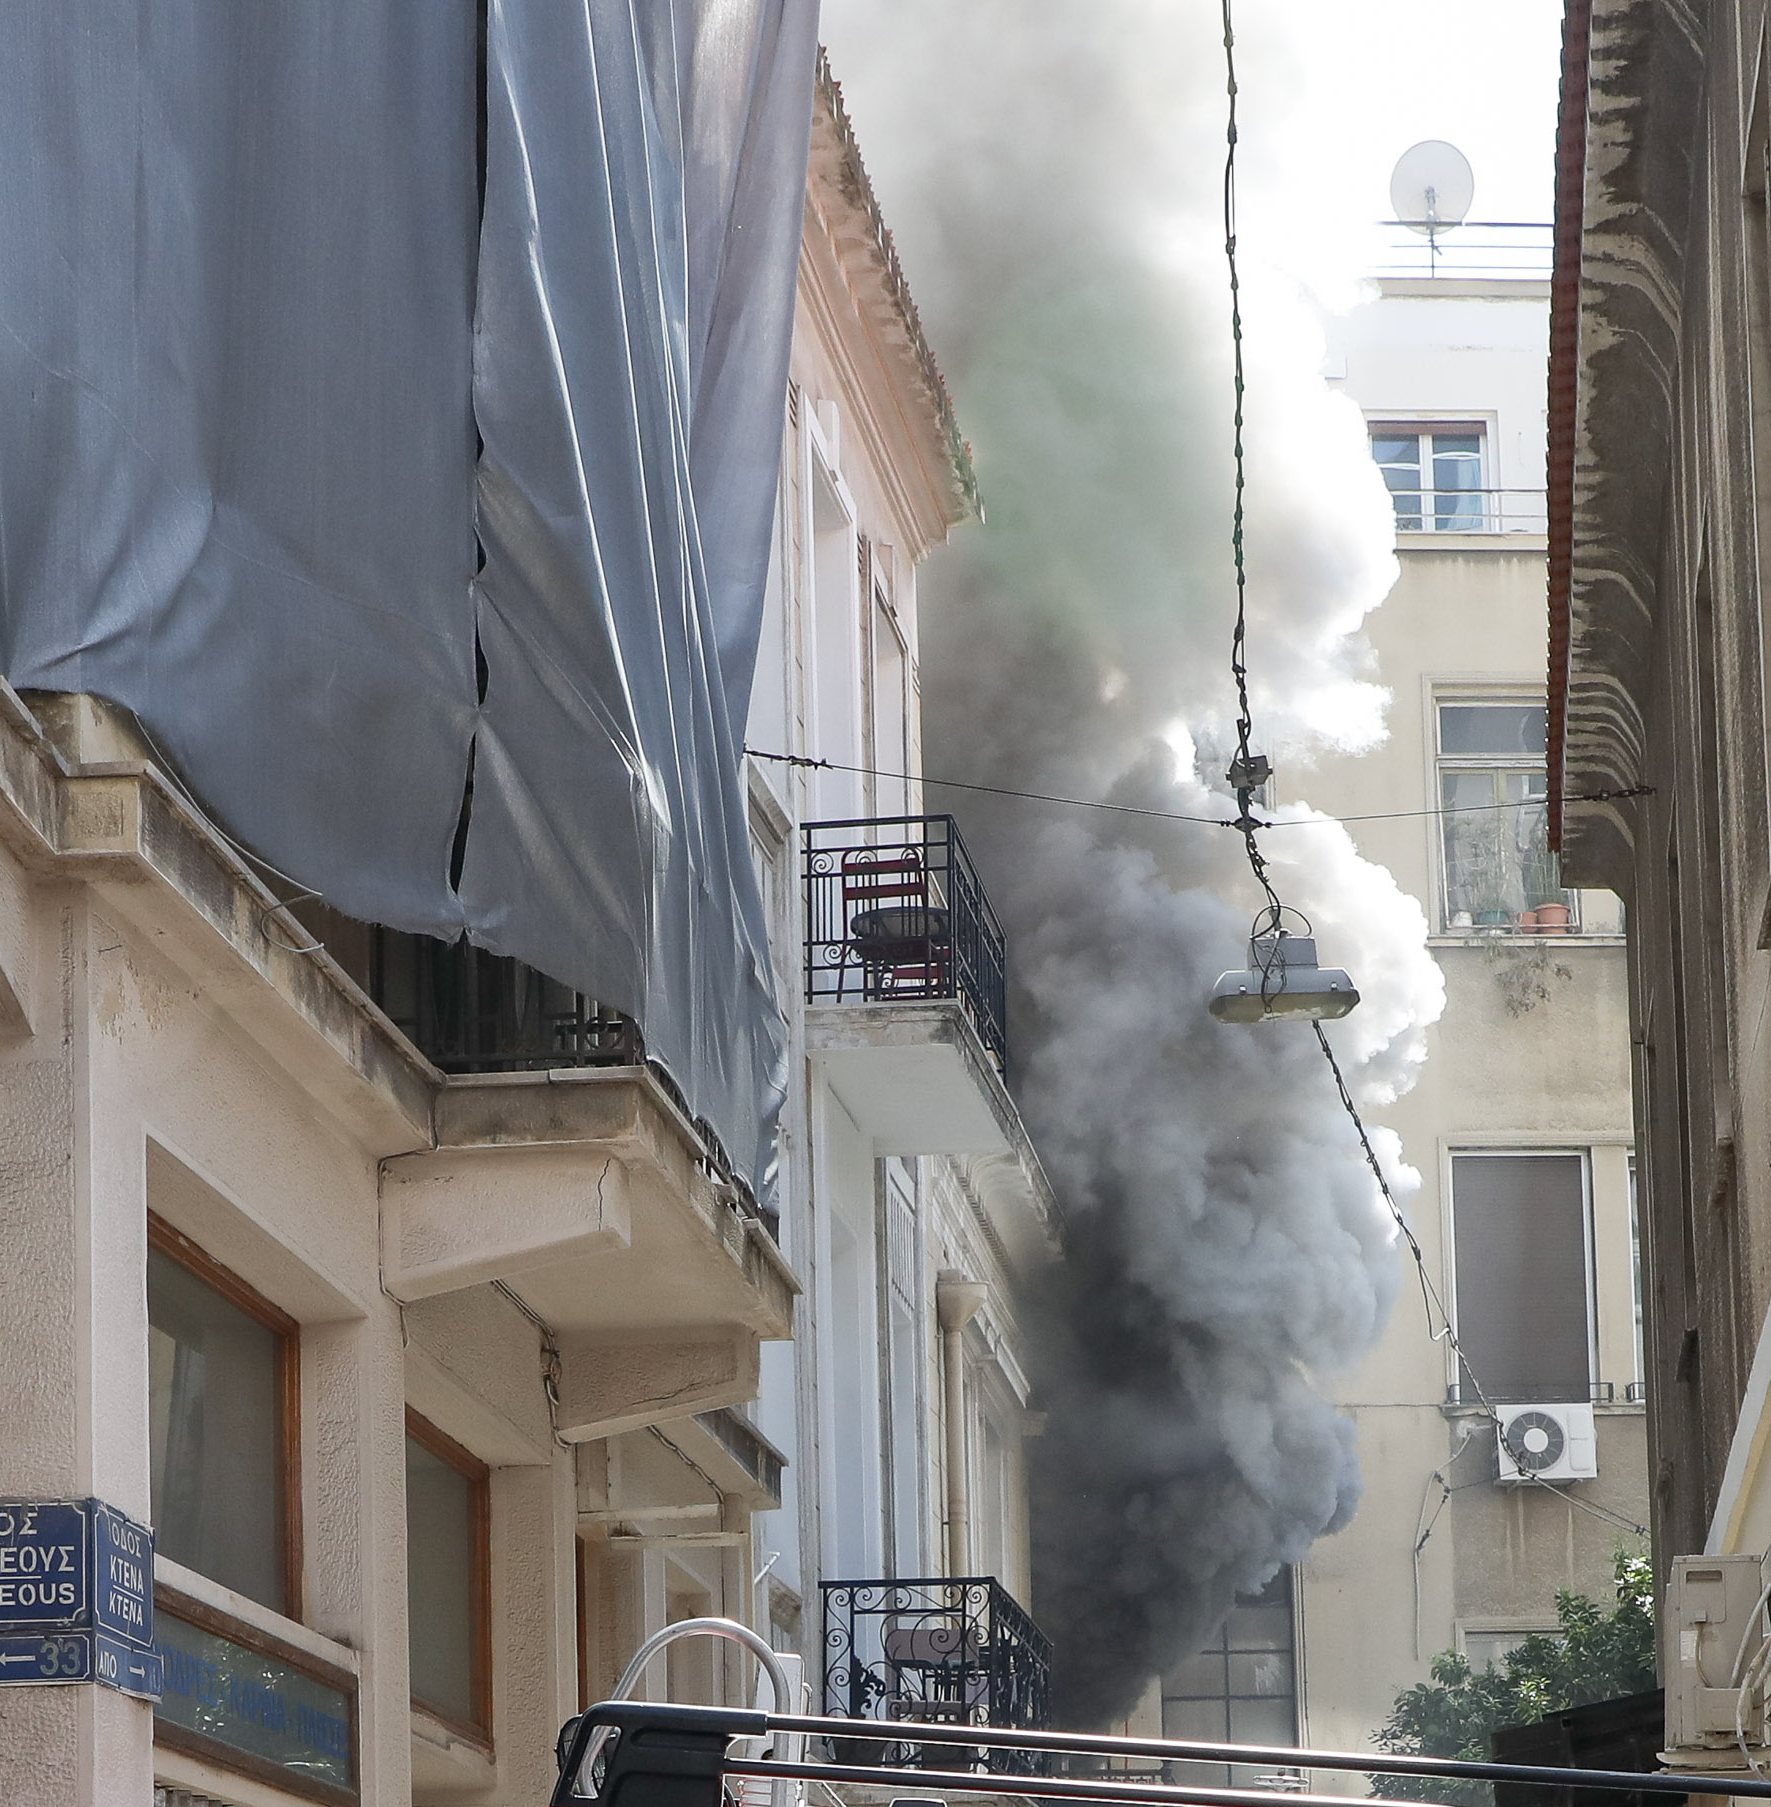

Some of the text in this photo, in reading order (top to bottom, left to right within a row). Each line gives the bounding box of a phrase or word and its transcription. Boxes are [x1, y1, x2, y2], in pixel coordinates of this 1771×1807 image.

[111, 1523, 142, 1558] ΟΔΟΣ
[39, 1641, 81, 1676] 33
[98, 1650, 118, 1679] ΑΠΟ
